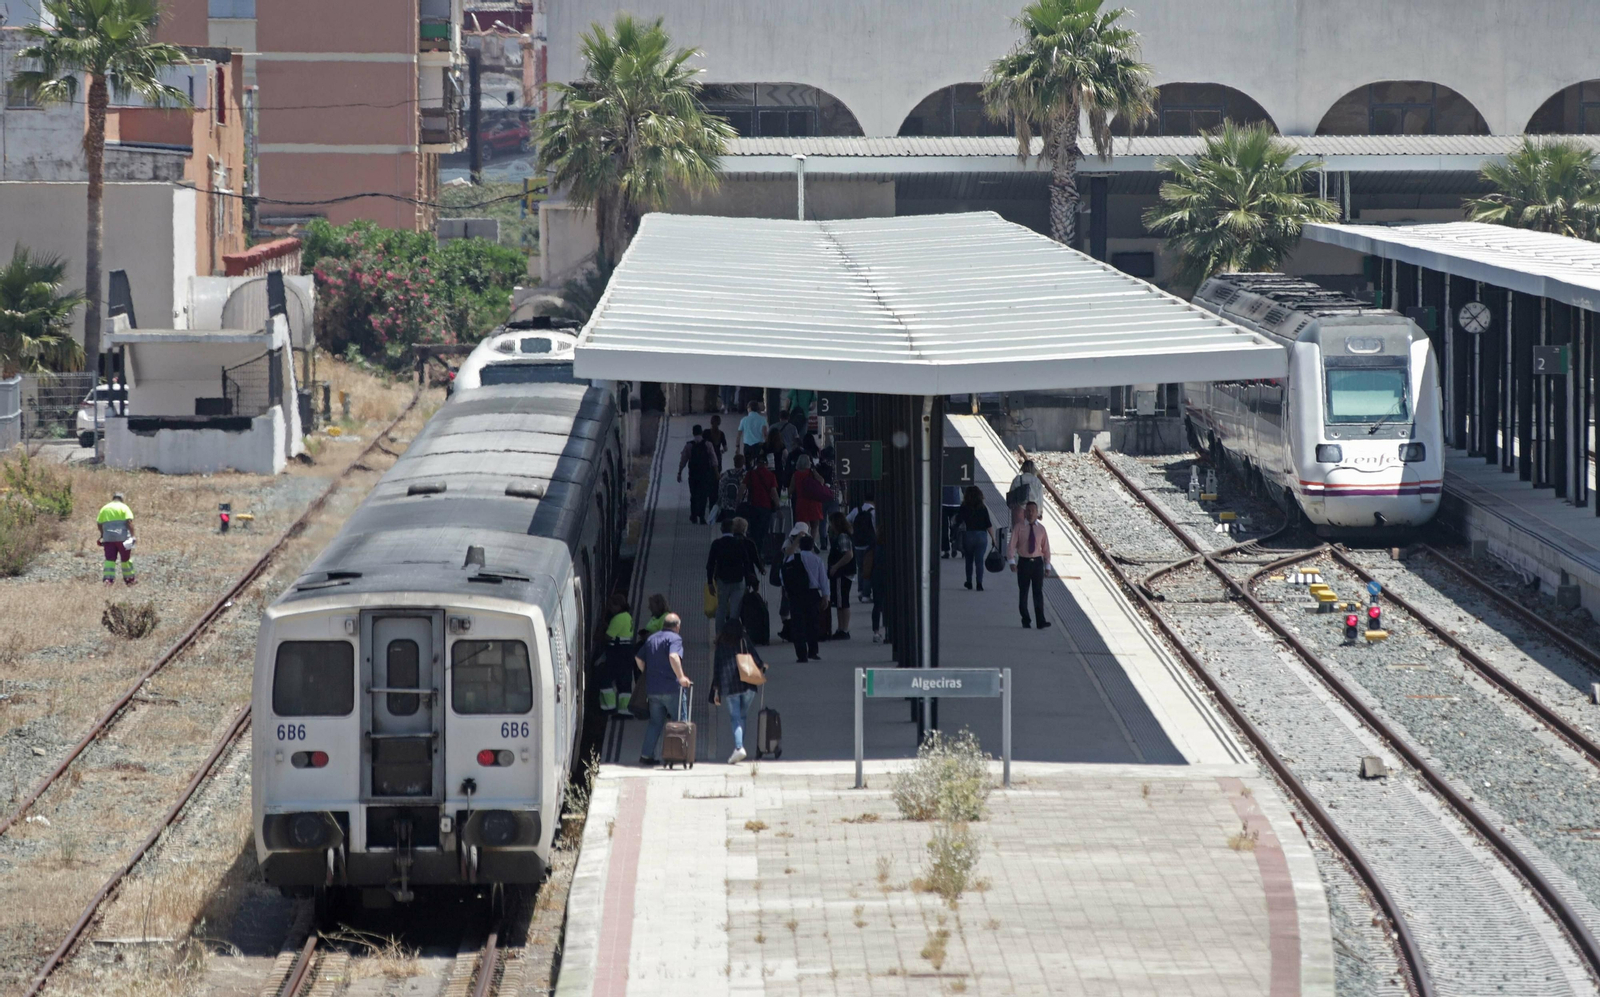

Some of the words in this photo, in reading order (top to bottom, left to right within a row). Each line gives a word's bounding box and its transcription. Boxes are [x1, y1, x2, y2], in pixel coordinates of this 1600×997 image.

[1537, 357, 1546, 371] 2
[821, 397, 830, 412] 3
[841, 458, 851, 475] 3
[1344, 452, 1396, 467] renfe
[960, 463, 971, 481] 1
[910, 677, 962, 691] Algeciras
[276, 724, 306, 741] 6B6
[500, 721, 530, 739] 6B6
